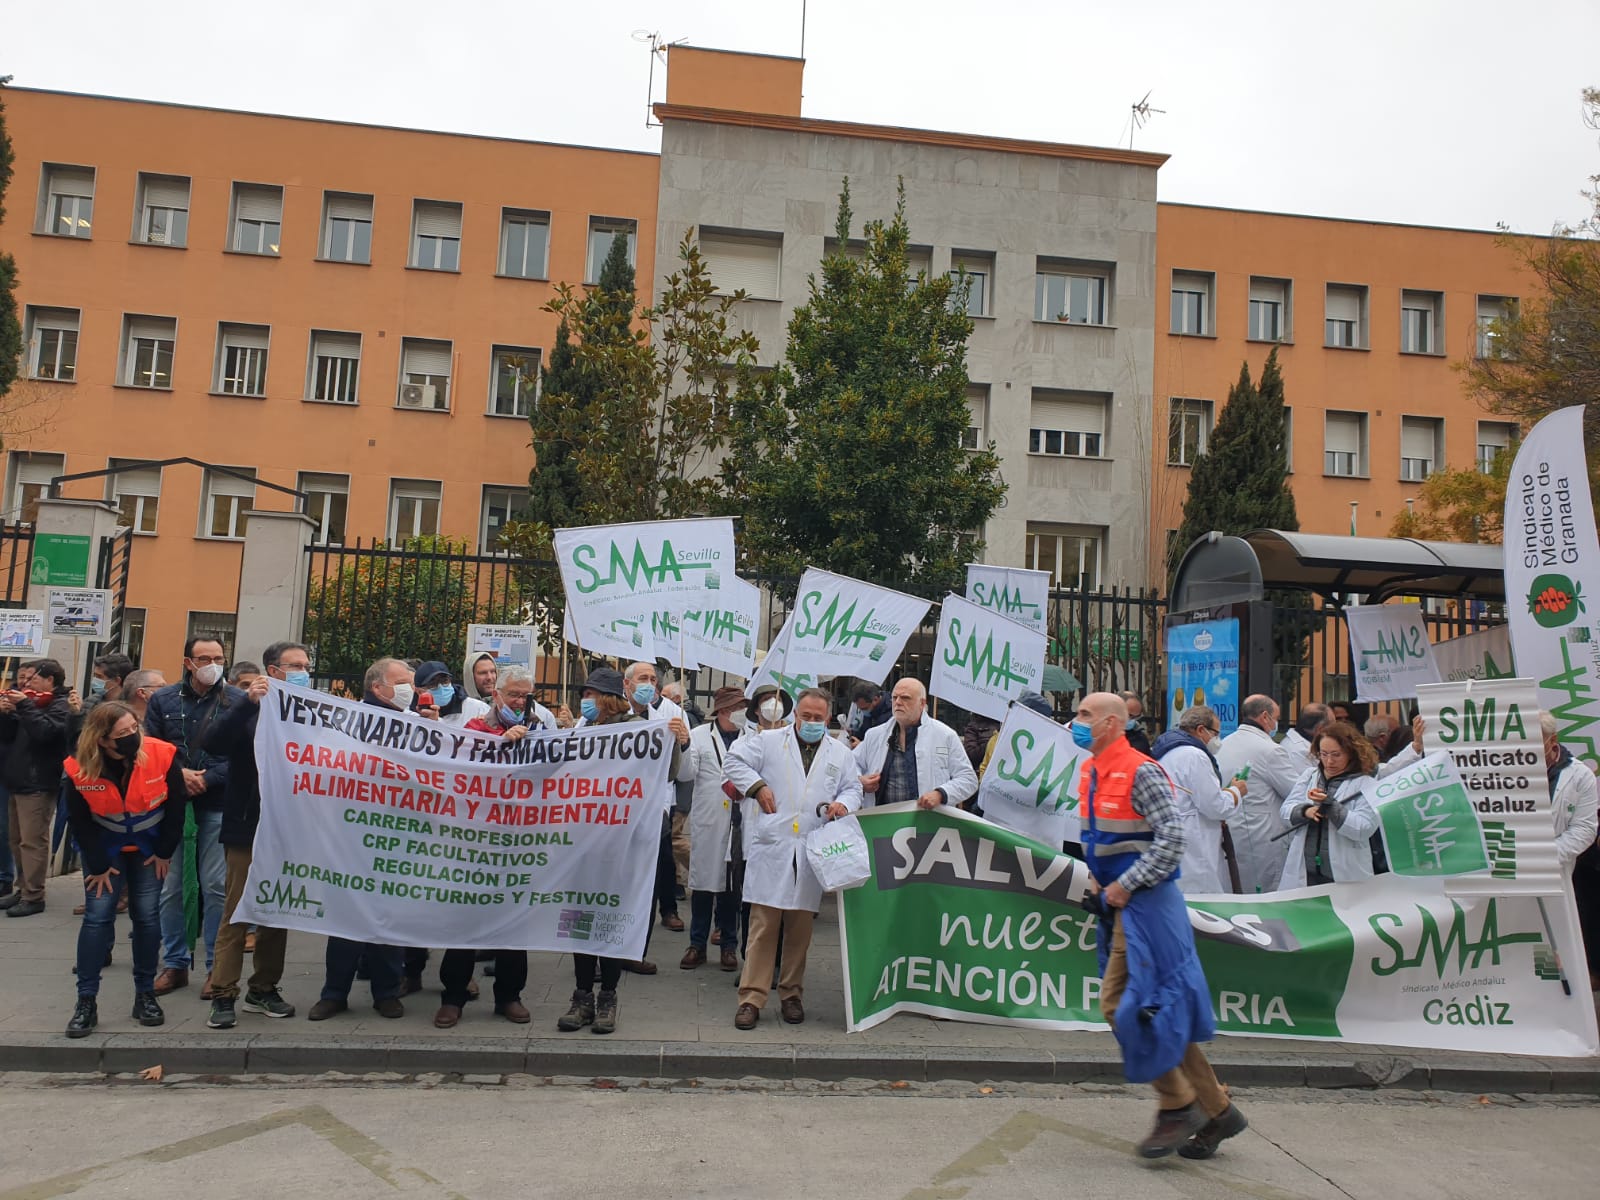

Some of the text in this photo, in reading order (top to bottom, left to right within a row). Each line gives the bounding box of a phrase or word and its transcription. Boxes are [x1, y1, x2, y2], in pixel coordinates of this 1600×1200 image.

[1522, 473, 1539, 569] Sindicato
[1537, 462, 1558, 567] Médico de
[1554, 477, 1579, 564] Granada
[572, 537, 712, 594] SMA
[677, 548, 721, 562] Sevilla
[795, 590, 887, 649] SMA
[972, 582, 1039, 615] SMA
[865, 617, 901, 637] Sevilla
[943, 618, 1029, 691] SMA
[1009, 655, 1036, 678] Sevilla
[278, 688, 665, 765] VETERINARIOS Y FARMACÉUTICOS
[1438, 698, 1527, 743] SMA
[284, 741, 644, 800] GARANTES DE SALÚD PÚBLICA
[1375, 763, 1450, 799] Cádiz
[1452, 749, 1538, 768] indicato
[292, 771, 630, 826] ¡ALIMENTARIA Y AMBIENTAL!
[343, 808, 574, 848] CARRERA PROFESIONAL
[362, 833, 549, 868] CRP FACULTATIVOS
[1413, 792, 1457, 870] SMA
[255, 877, 323, 910] SMA
[281, 860, 621, 908] HORARIOS NOCTURNOS Y FESTIVOS
[372, 856, 532, 888] REGULACIÓN DE
[1368, 898, 1543, 980] SMA
[872, 955, 1067, 1010] ATENCIÓN
[1472, 975, 1507, 987] Andaluz
[1423, 994, 1514, 1026] Cádiz
